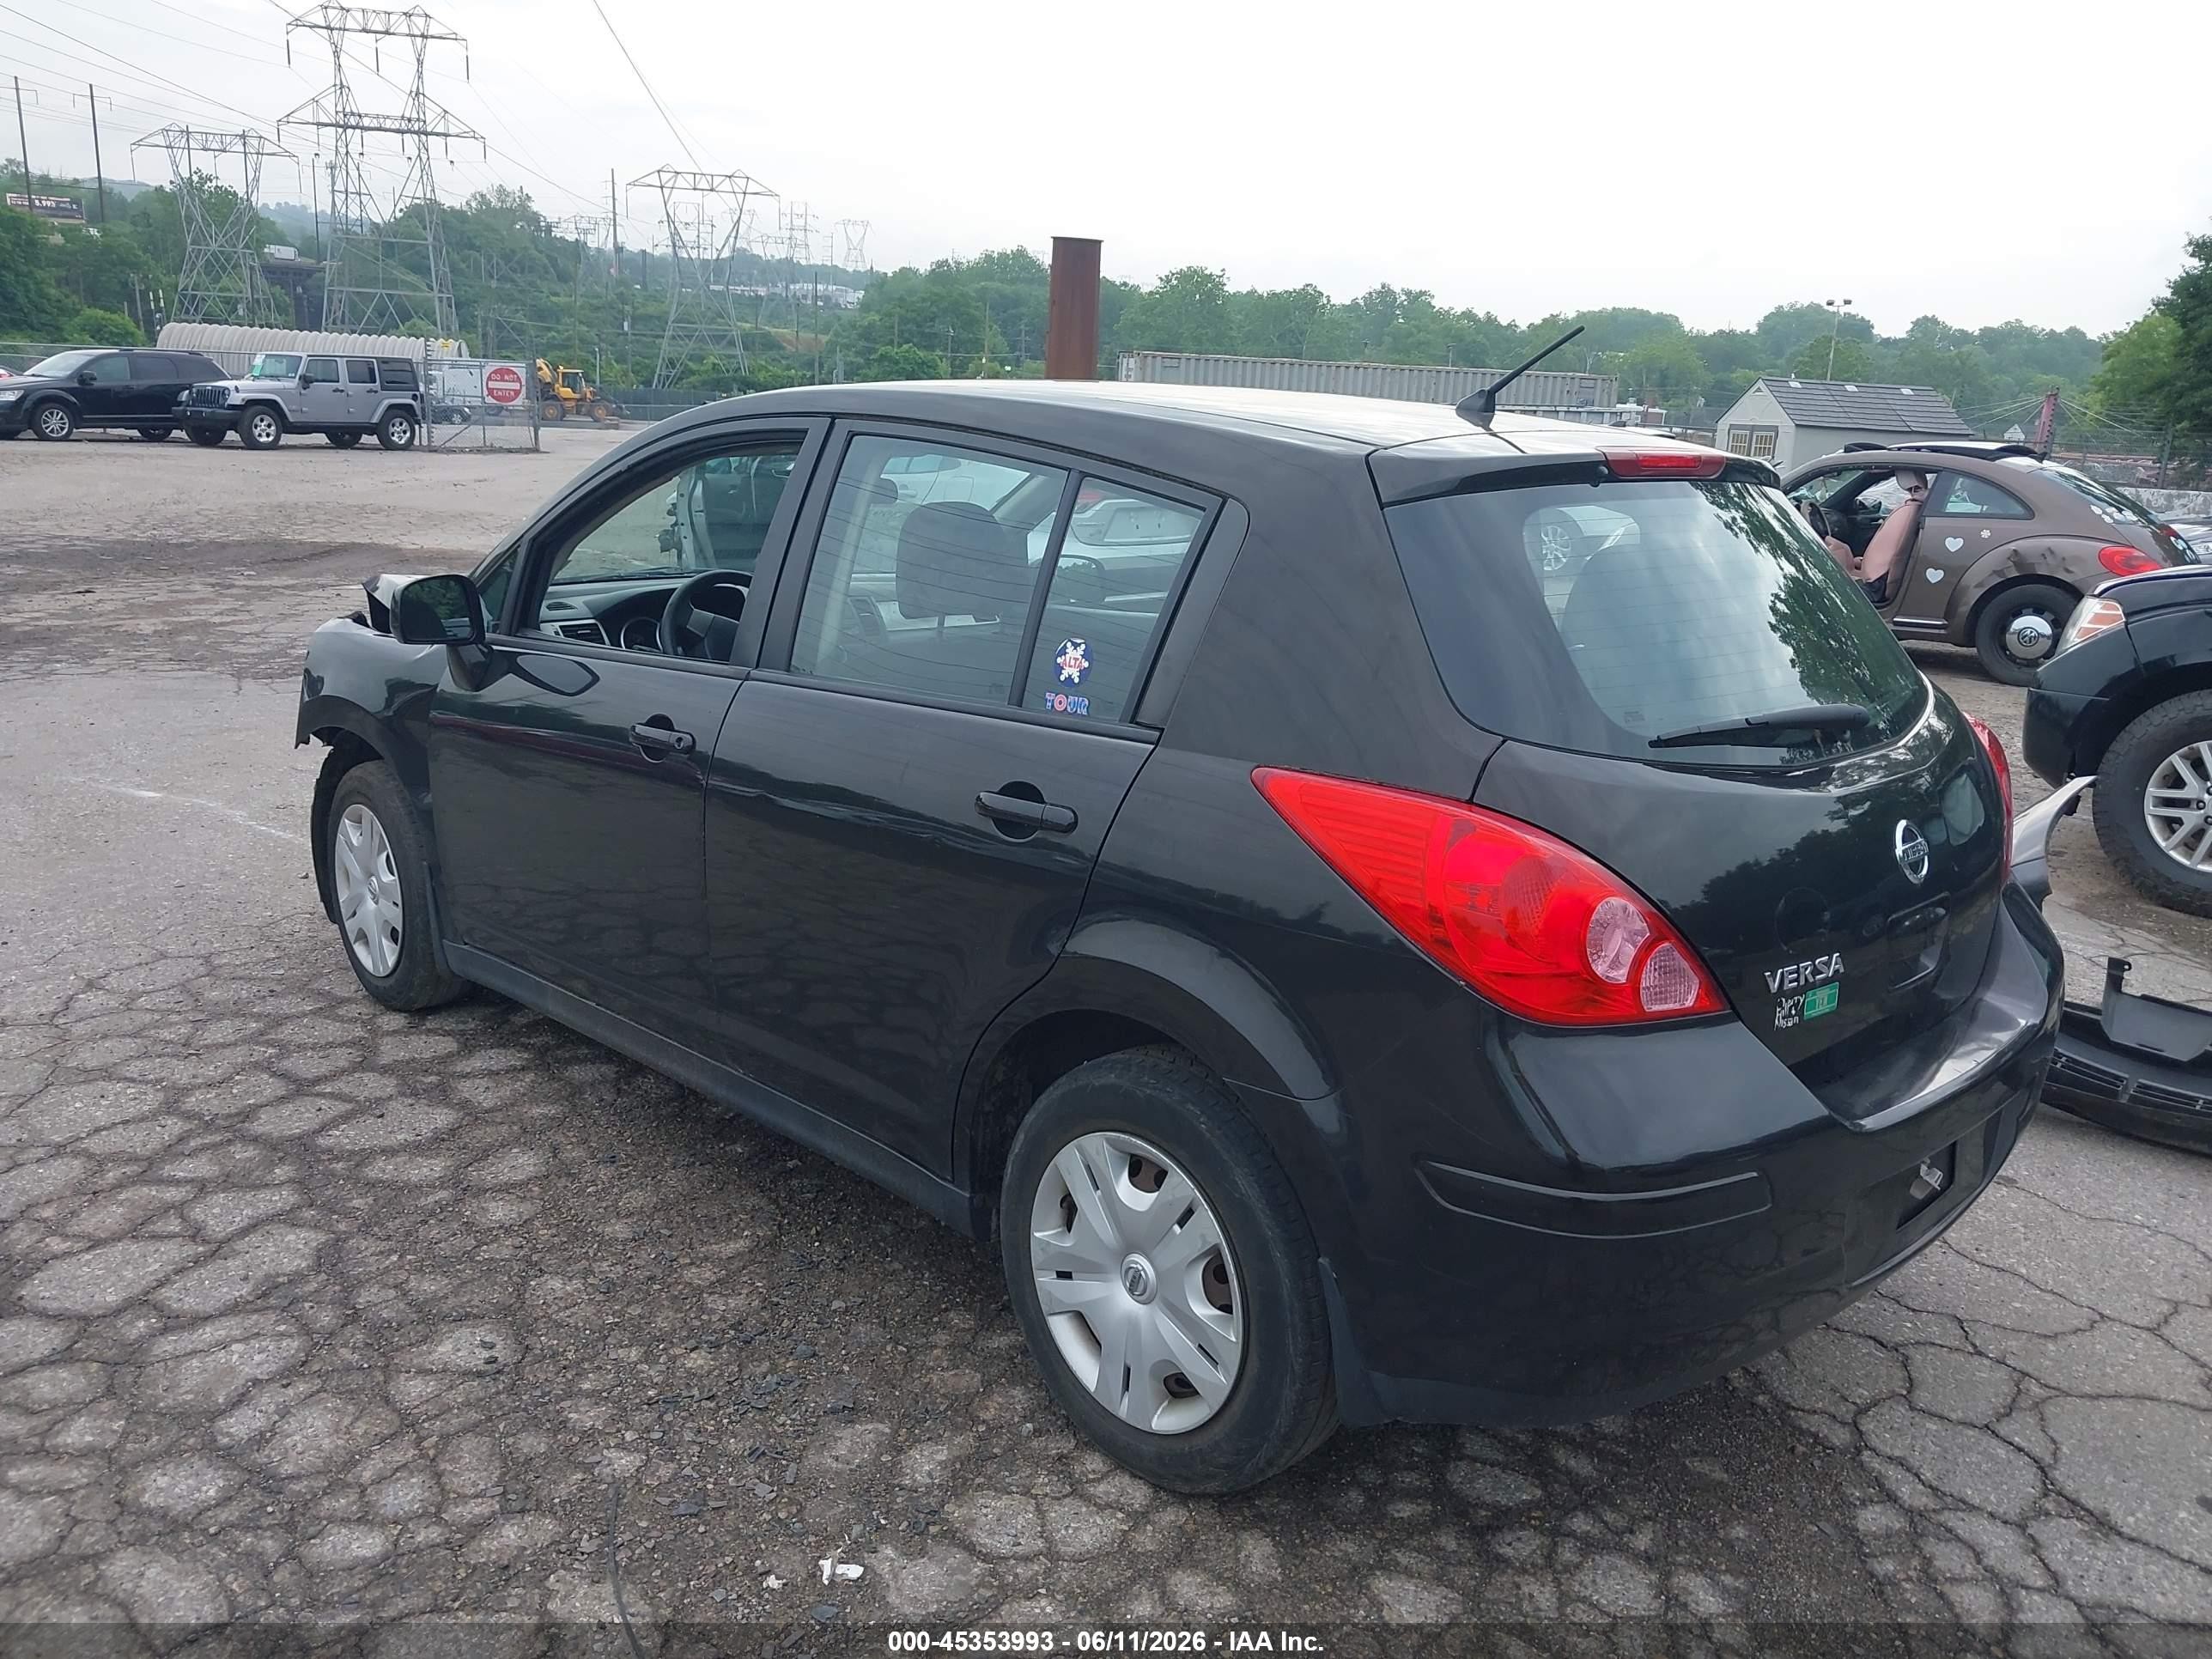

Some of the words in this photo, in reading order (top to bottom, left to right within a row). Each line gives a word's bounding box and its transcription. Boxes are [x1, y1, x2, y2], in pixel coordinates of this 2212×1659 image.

[504, 374, 518, 382] NOT
[493, 389, 515, 398] ENTER
[1061, 655, 1085, 670] ALTA
[1045, 692, 1090, 715] TOUR
[1764, 952, 1844, 994] VERSA
